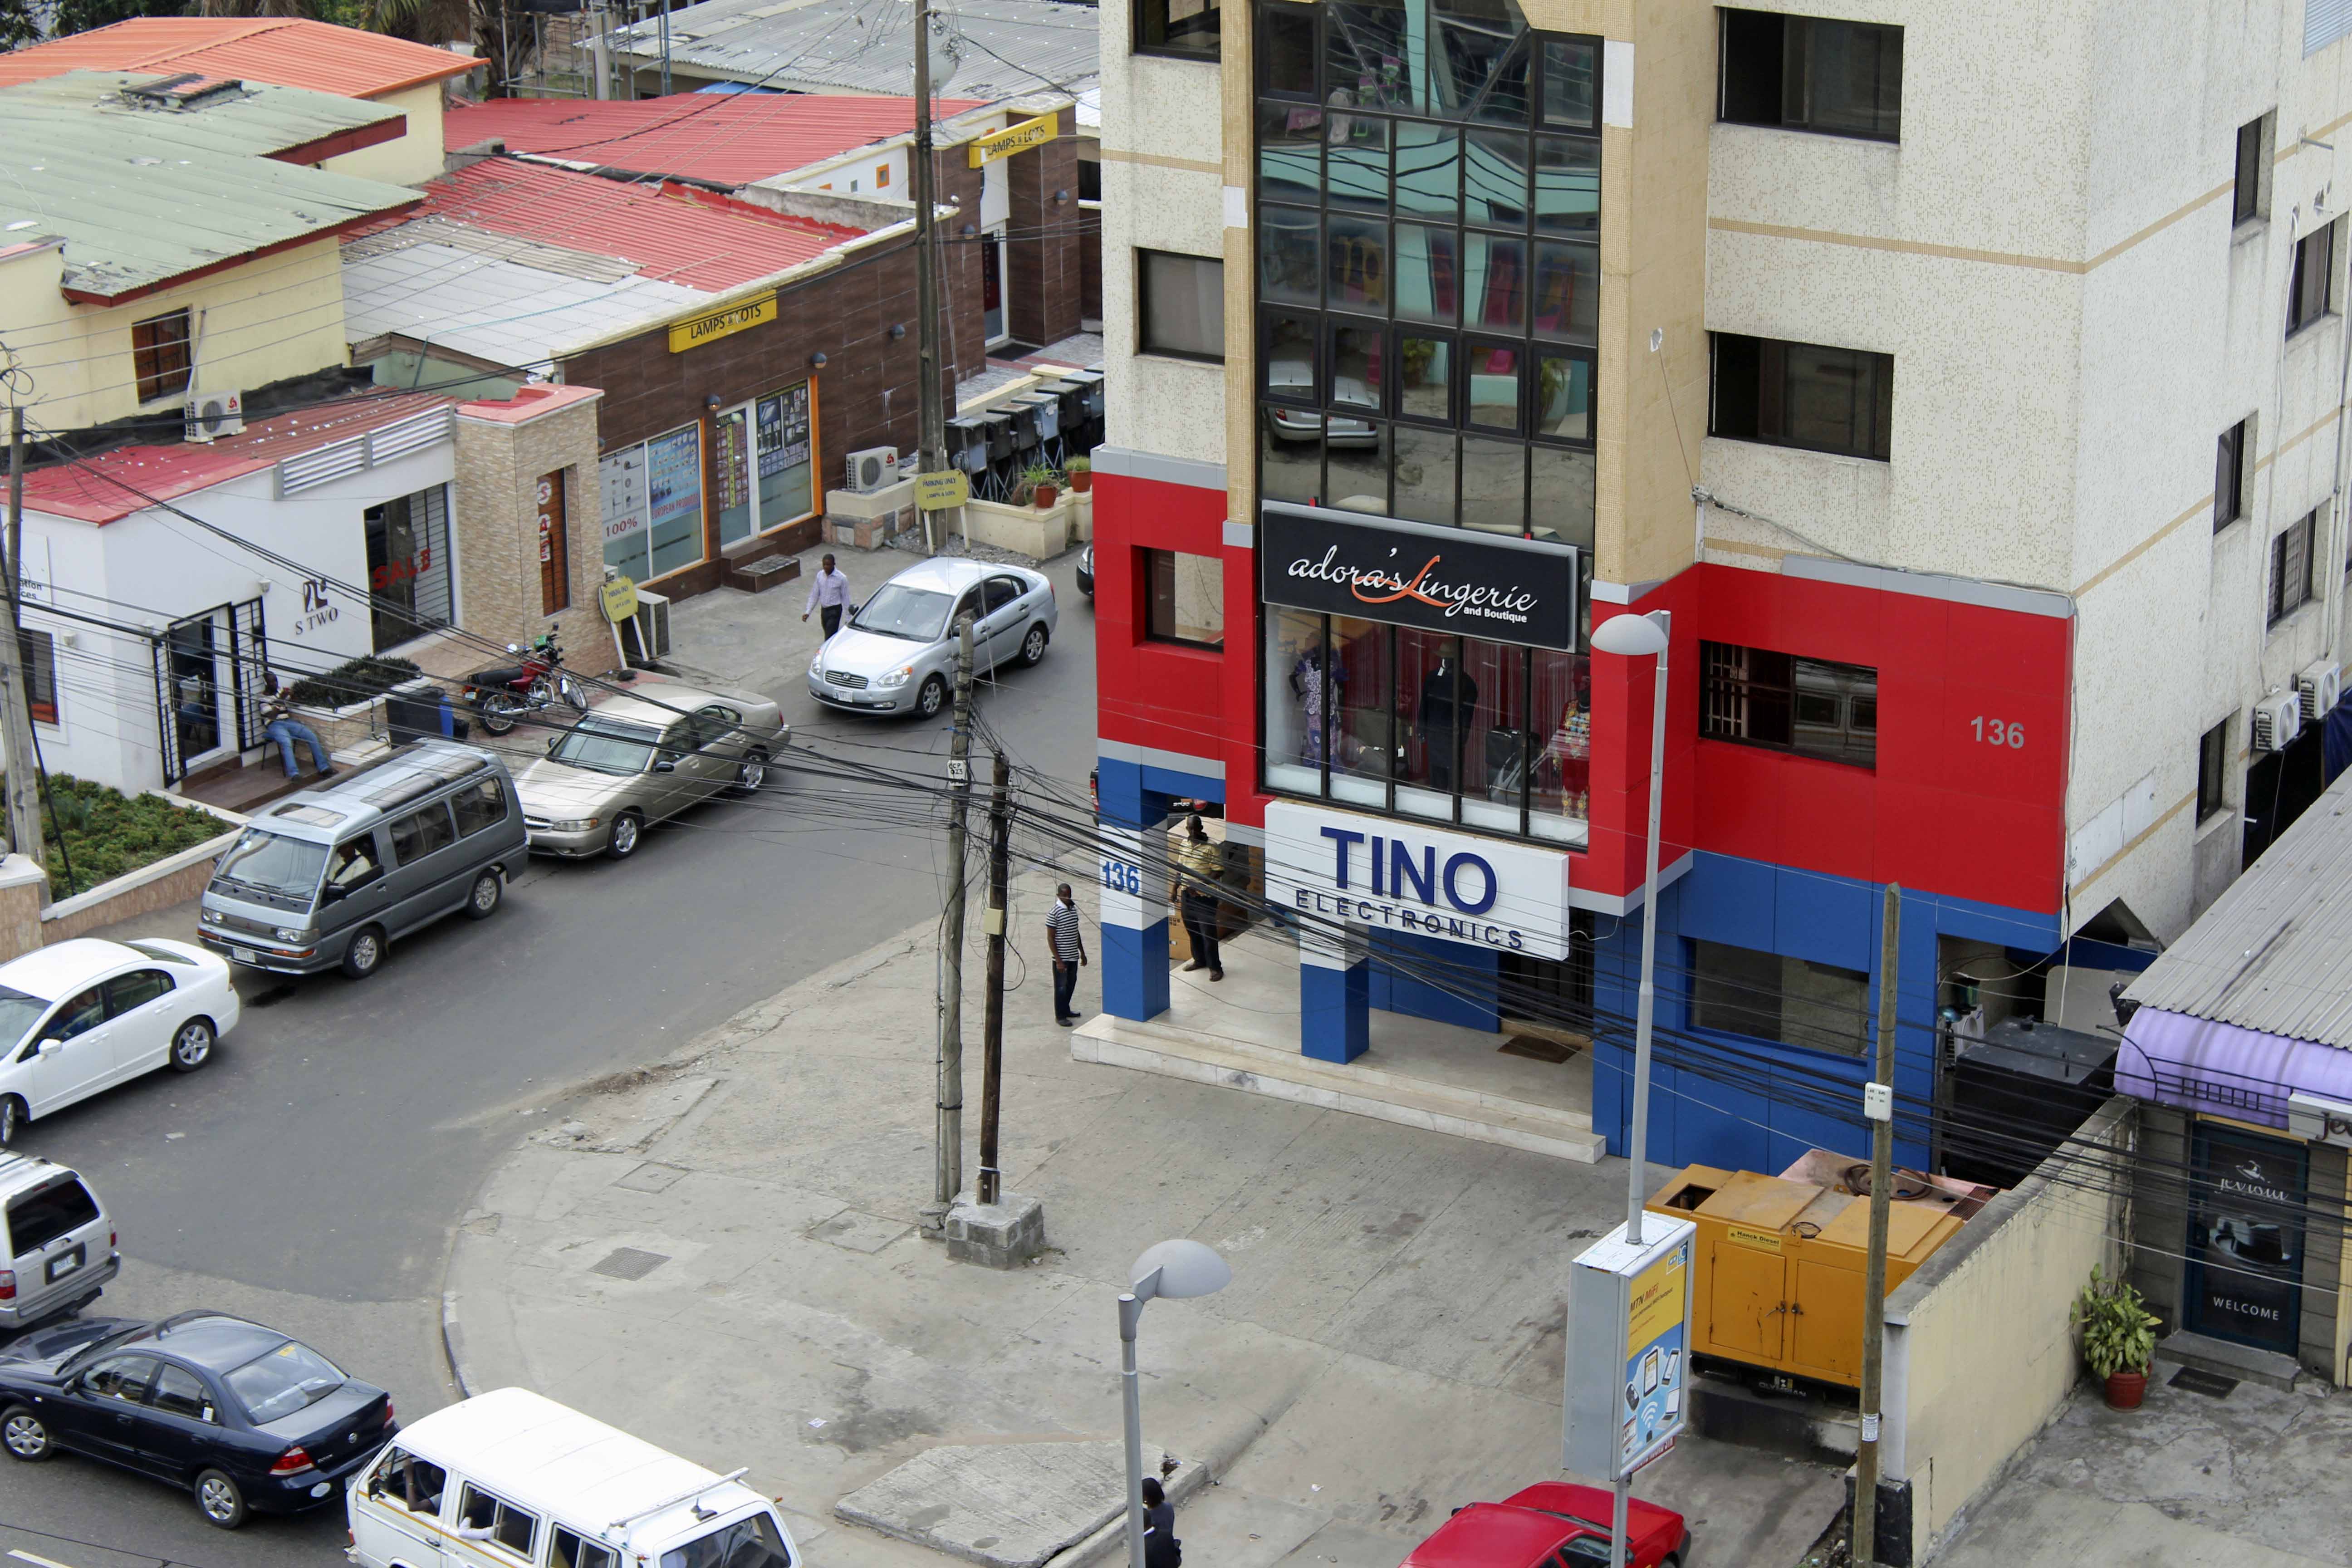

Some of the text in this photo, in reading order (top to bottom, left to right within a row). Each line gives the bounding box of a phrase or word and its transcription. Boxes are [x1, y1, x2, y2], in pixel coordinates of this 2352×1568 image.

[691, 316, 725, 339] LAMPS
[735, 303, 761, 323] LOTS
[606, 516, 637, 538] 100%
[372, 547, 431, 590] SALE
[1288, 544, 1410, 591] adora's
[295, 608, 338, 636] S TWO
[1463, 606, 1528, 623] and Boutique
[1970, 715, 2025, 749] 136
[1102, 861, 1139, 896] 136
[1320, 826, 1499, 916] TINO
[1296, 889, 1525, 951] ELECTRONICS
[1737, 1231, 1758, 1240] Hanck
[1759, 1236, 1779, 1245] Diesel
[1629, 1293, 1645, 1313] MTN
[2213, 1296, 2279, 1321] WELCOME
